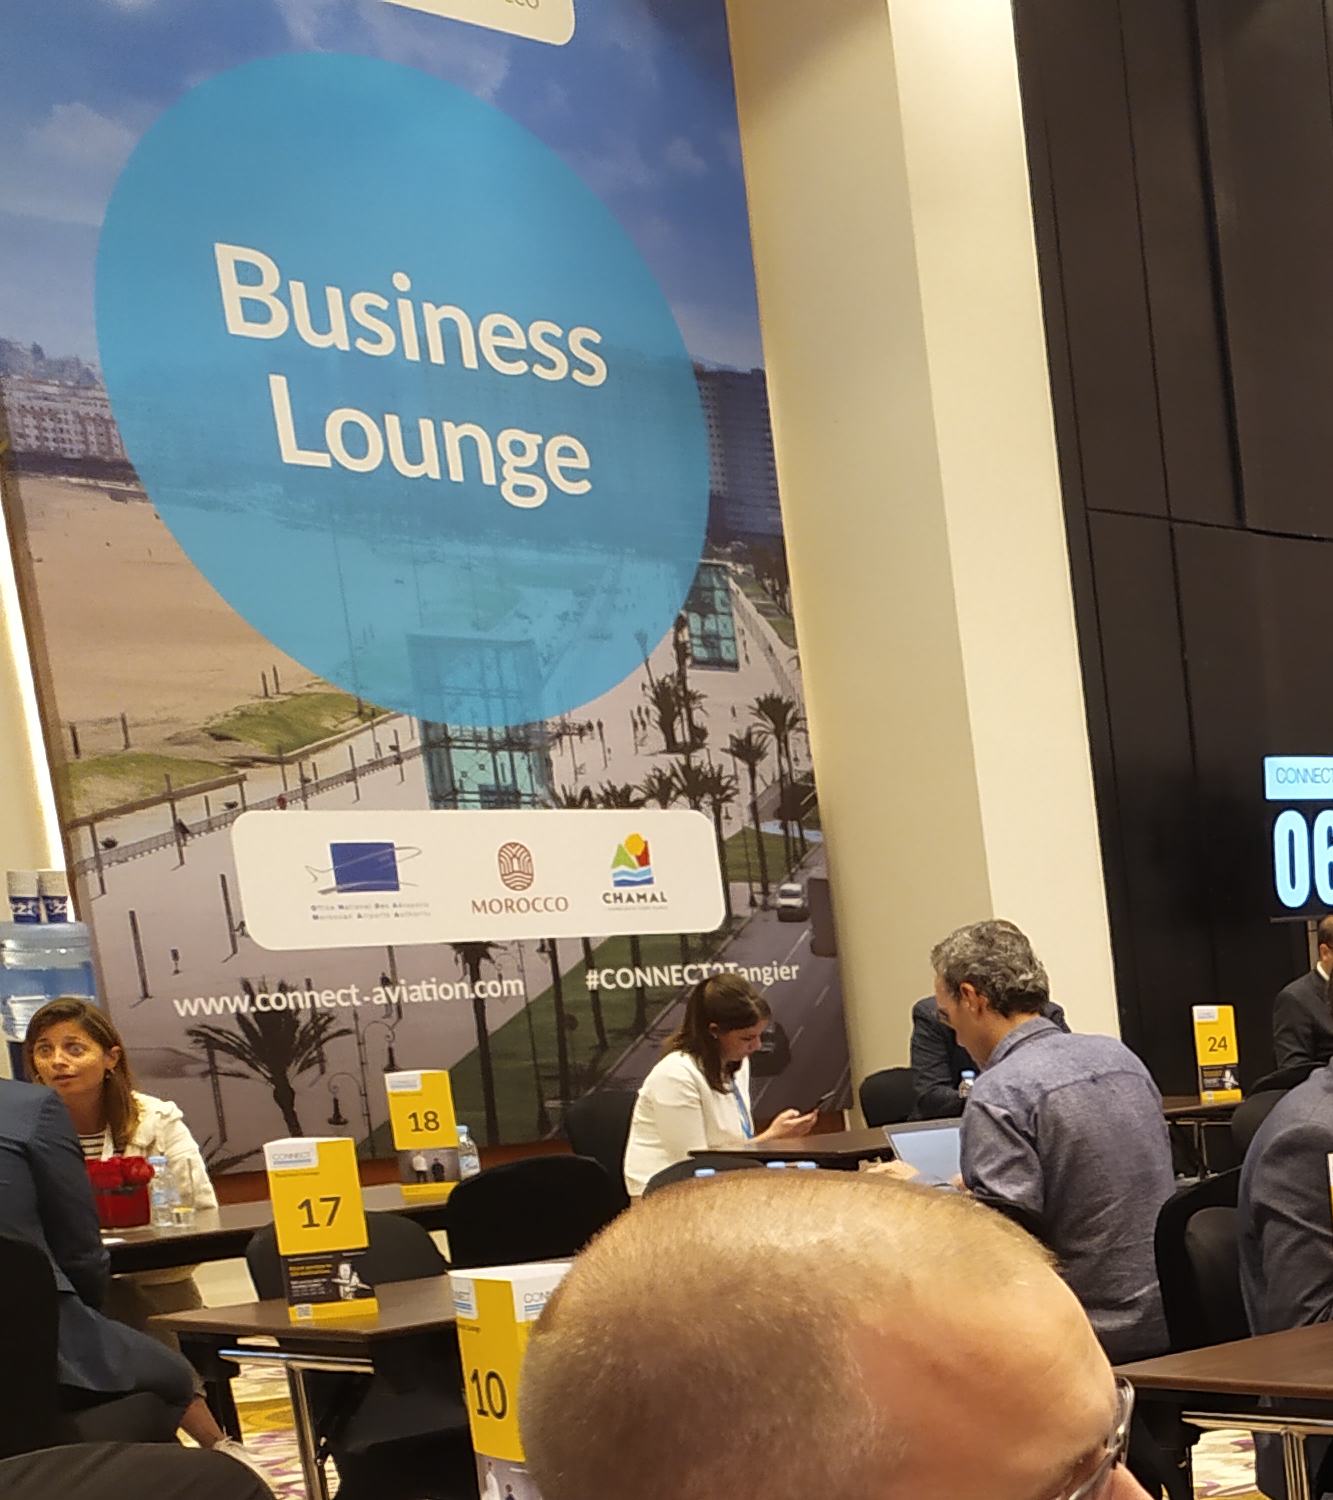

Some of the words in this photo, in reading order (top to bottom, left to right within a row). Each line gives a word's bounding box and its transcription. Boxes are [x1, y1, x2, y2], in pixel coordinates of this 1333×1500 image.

[212, 242, 608, 388] Business
[268, 374, 592, 510] Lounge
[471, 896, 570, 915] MOROCCO
[602, 891, 668, 904] CHAMAL
[173, 977, 525, 1017] www.connect-aviation.com
[1207, 1036, 1228, 1052] 24
[407, 1110, 440, 1132] 18
[272, 1151, 312, 1161] CONNECT
[297, 1196, 342, 1228] 17
[470, 1368, 508, 1420] 10
